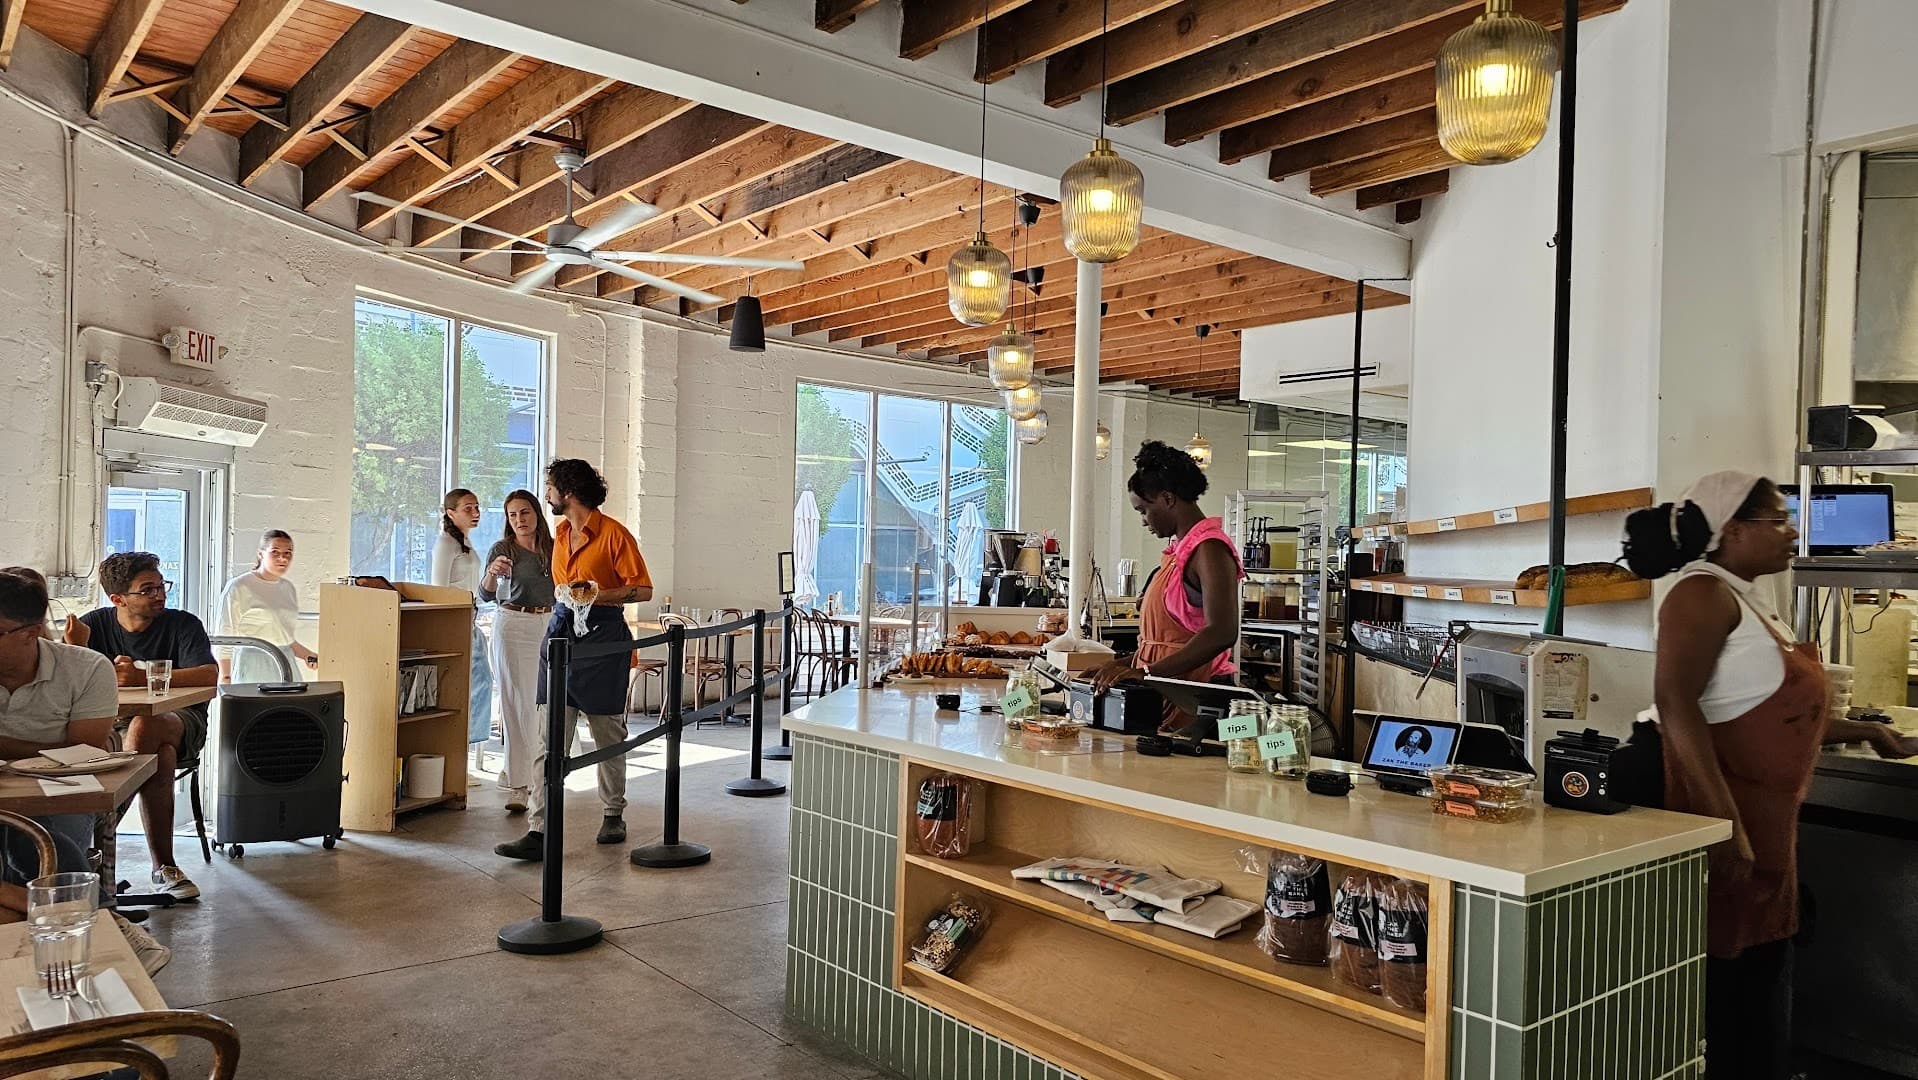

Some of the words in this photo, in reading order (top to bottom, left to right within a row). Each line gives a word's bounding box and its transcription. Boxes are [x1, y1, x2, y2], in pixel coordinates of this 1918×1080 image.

[188, 330, 216, 365] EXIT
[1007, 696, 1022, 708] tips
[1227, 723, 1248, 734] tips
[1266, 739, 1286, 750] tips
